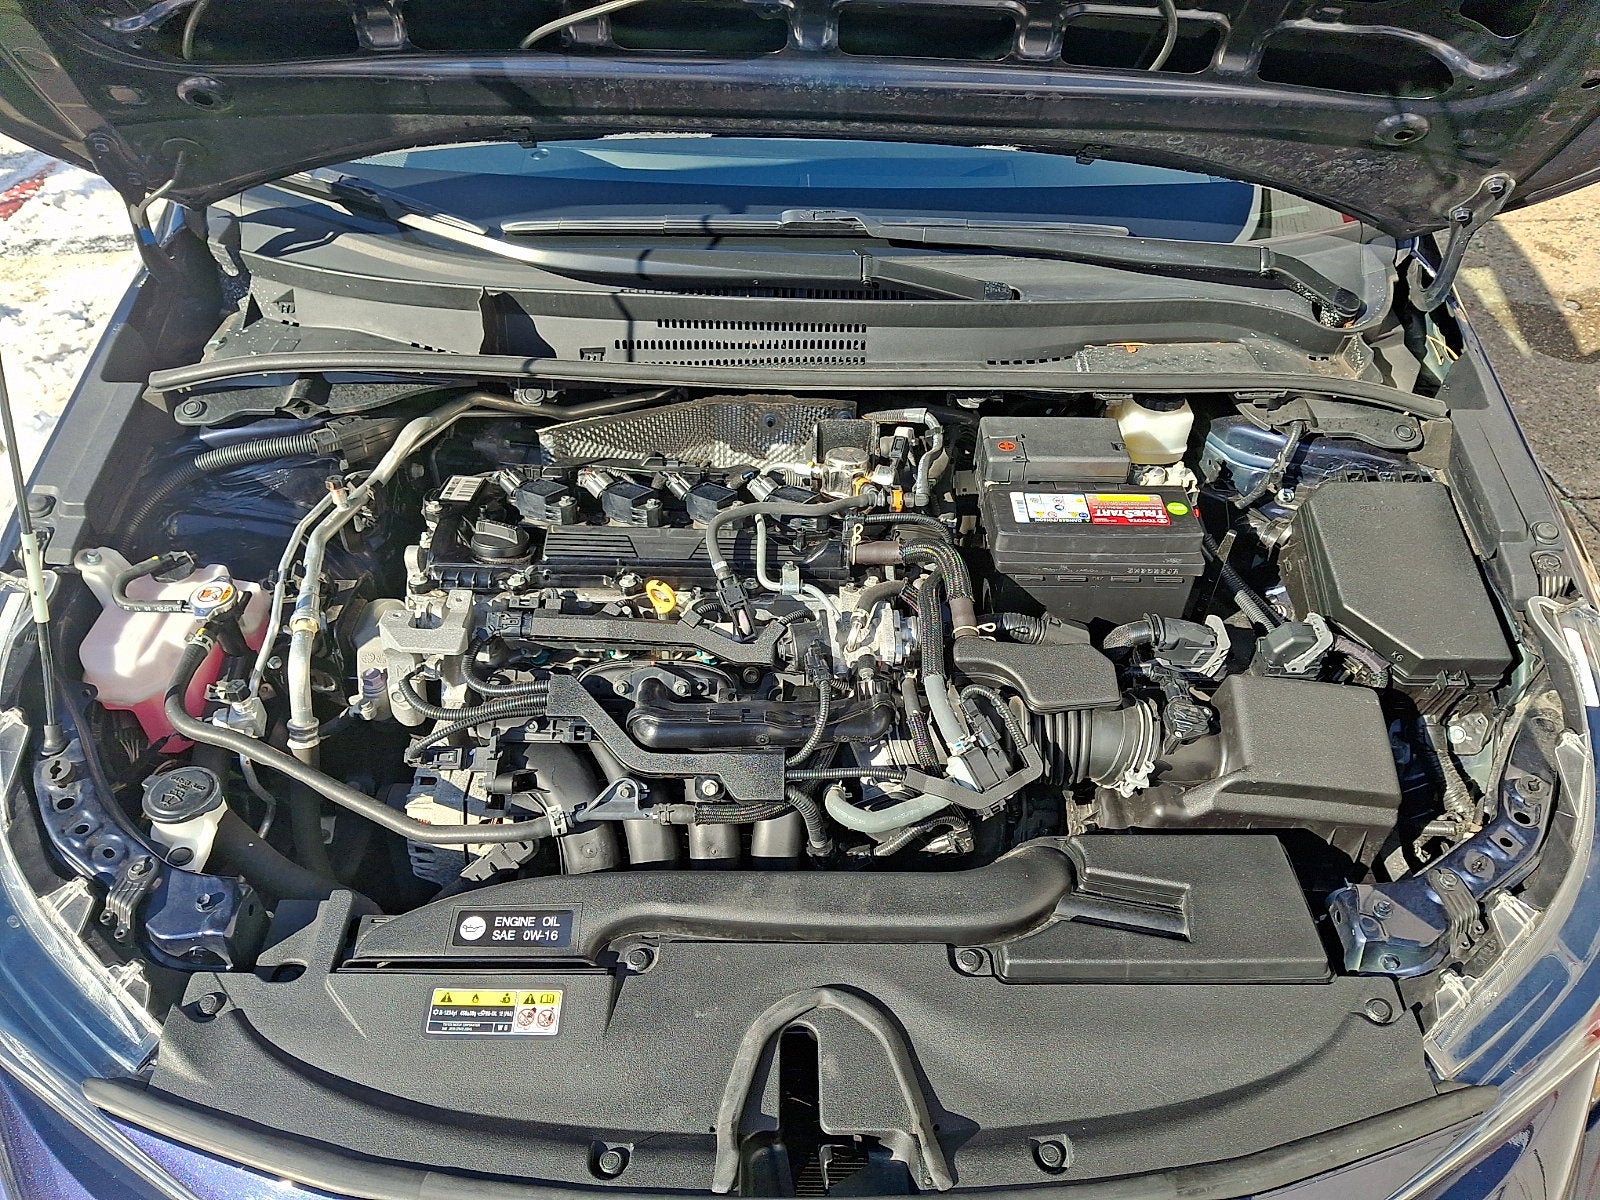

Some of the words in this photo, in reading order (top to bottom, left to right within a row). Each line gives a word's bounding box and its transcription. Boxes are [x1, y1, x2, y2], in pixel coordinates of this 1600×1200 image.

[494, 916, 536, 927] ENGINE
[542, 916, 561, 927] OIL
[491, 930, 516, 941] SAE
[523, 930, 559, 941] 0W-16
